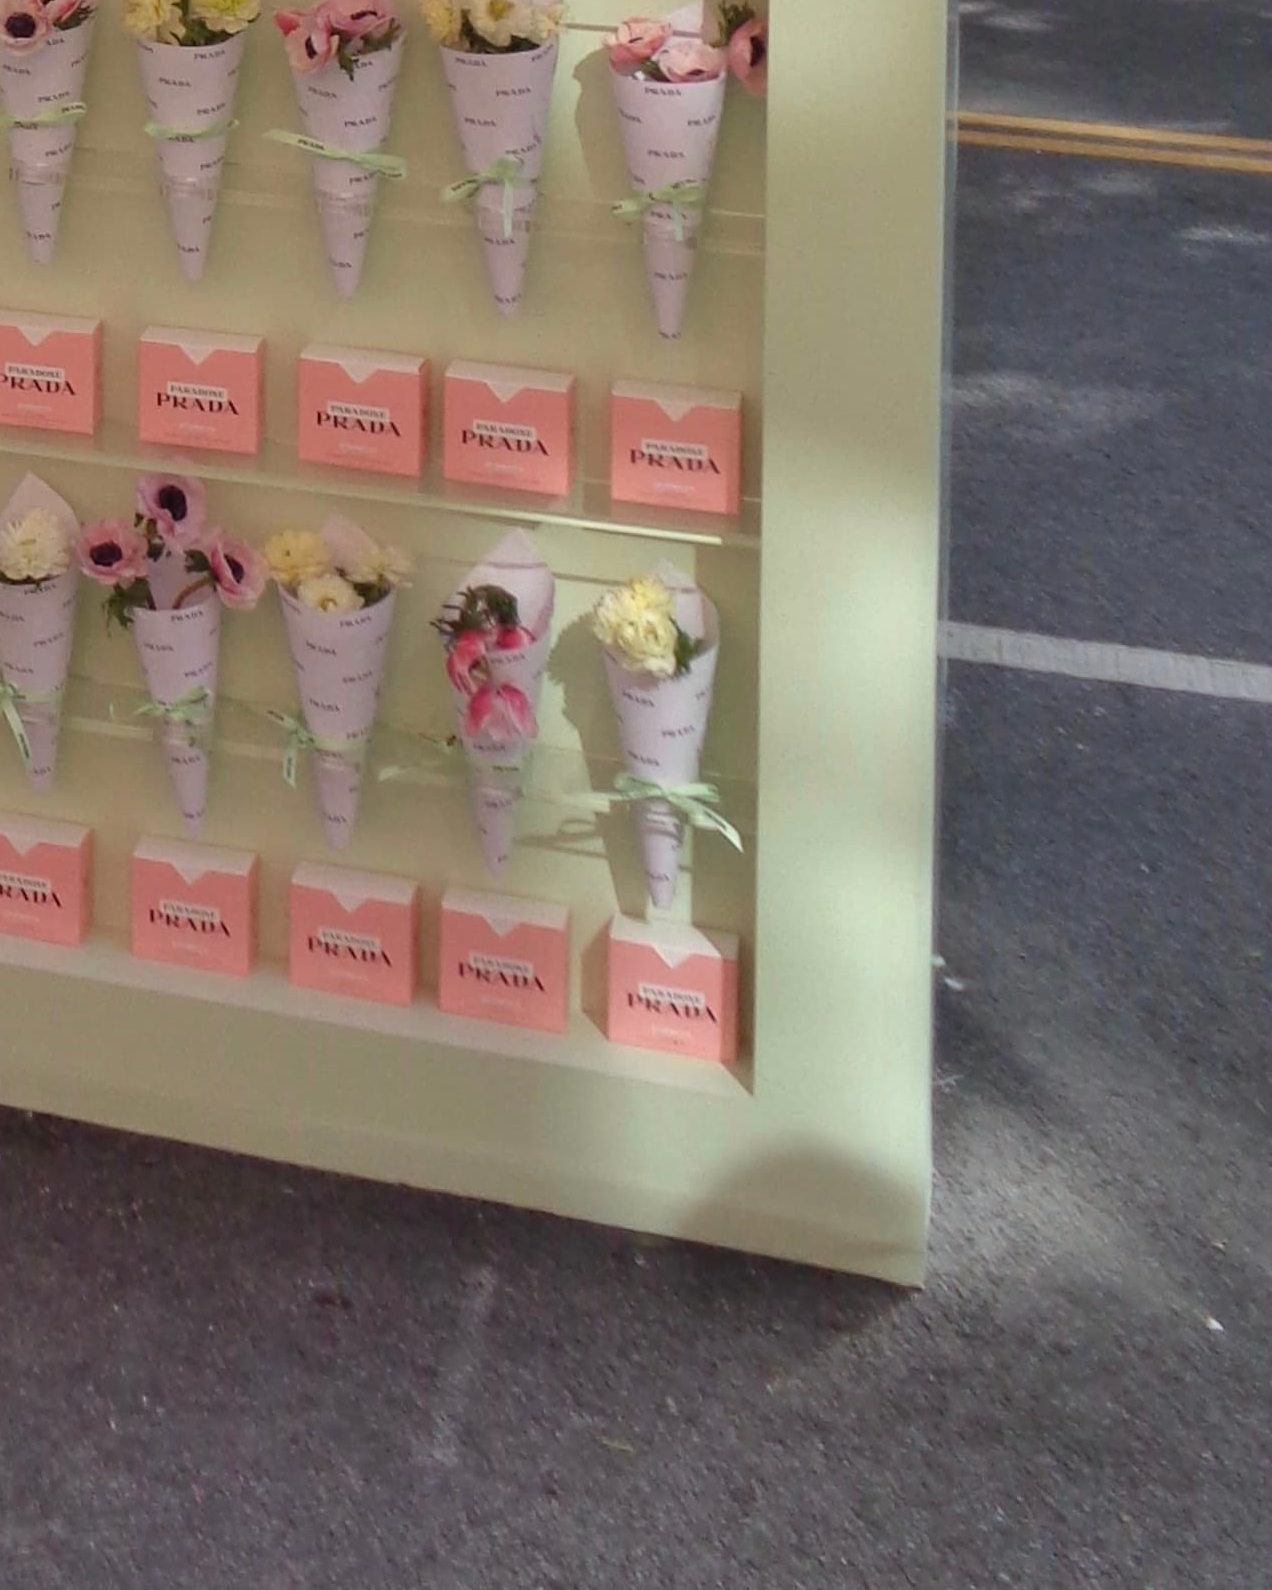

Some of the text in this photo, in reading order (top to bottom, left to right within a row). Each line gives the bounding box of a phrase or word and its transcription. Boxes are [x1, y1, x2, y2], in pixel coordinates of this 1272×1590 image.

[194, 50, 225, 60] PRADA
[159, 78, 191, 87] PRADA
[38, 91, 70, 102] PRADA
[495, 87, 531, 97] PRADA
[645, 87, 681, 97] PRADA
[344, 117, 377, 127] PRADA
[464, 117, 496, 127] PRADA
[648, 150, 685, 159] PRADA
[157, 392, 239, 414] PRADA
[316, 411, 401, 437] PRADA
[462, 430, 549, 456] PRADA
[630, 449, 721, 474] PRADA
[150, 909, 231, 937] PRADA
[308, 936, 392, 967] PRADA
[459, 962, 545, 992] PRADA
[628, 993, 718, 1023] PRADA
